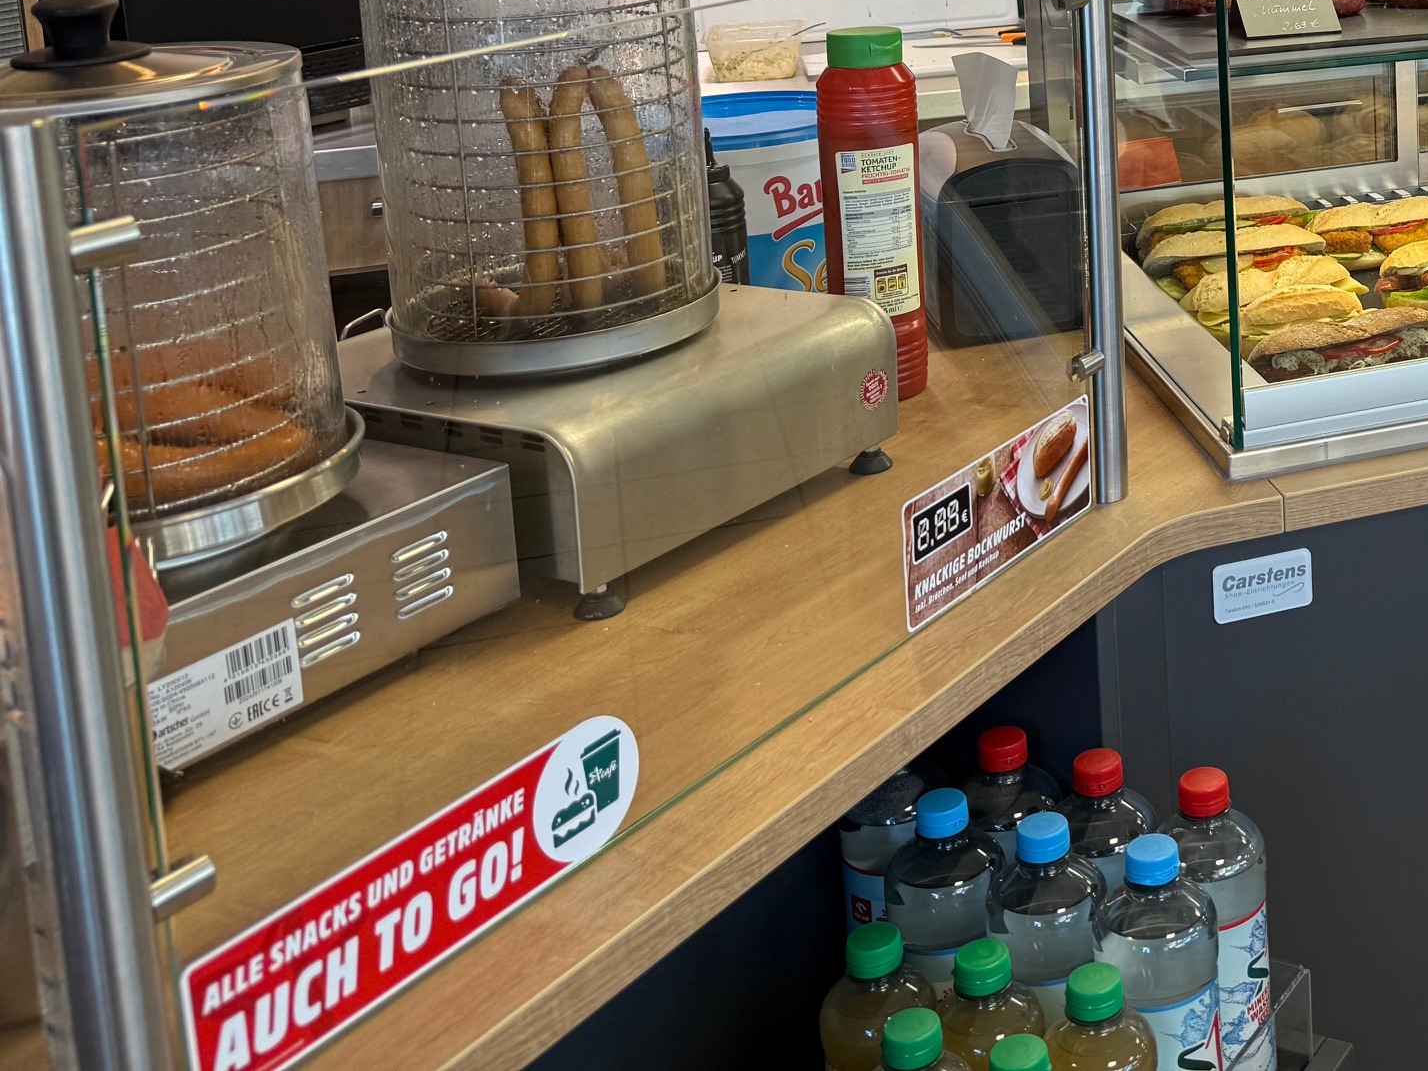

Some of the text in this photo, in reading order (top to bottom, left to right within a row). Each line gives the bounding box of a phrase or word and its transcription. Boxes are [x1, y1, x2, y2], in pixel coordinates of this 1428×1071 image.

[861, 155, 901, 166] TOMATEN-
[861, 163, 897, 173] KETCHUP
[914, 512, 1026, 600] KNACKIGE BOCKWURST
[955, 575, 967, 587] Senf
[968, 564, 978, 578] und
[979, 551, 999, 570] Ketchup
[1222, 564, 1306, 592] Carstens
[1225, 580, 1295, 600] Shop-Einrichtungen
[190, 709, 211, 723] GmbH
[202, 788, 525, 1017] ALLE SNACKS UND GETRÄNKE
[215, 828, 525, 1071] AUCH TO GO!
